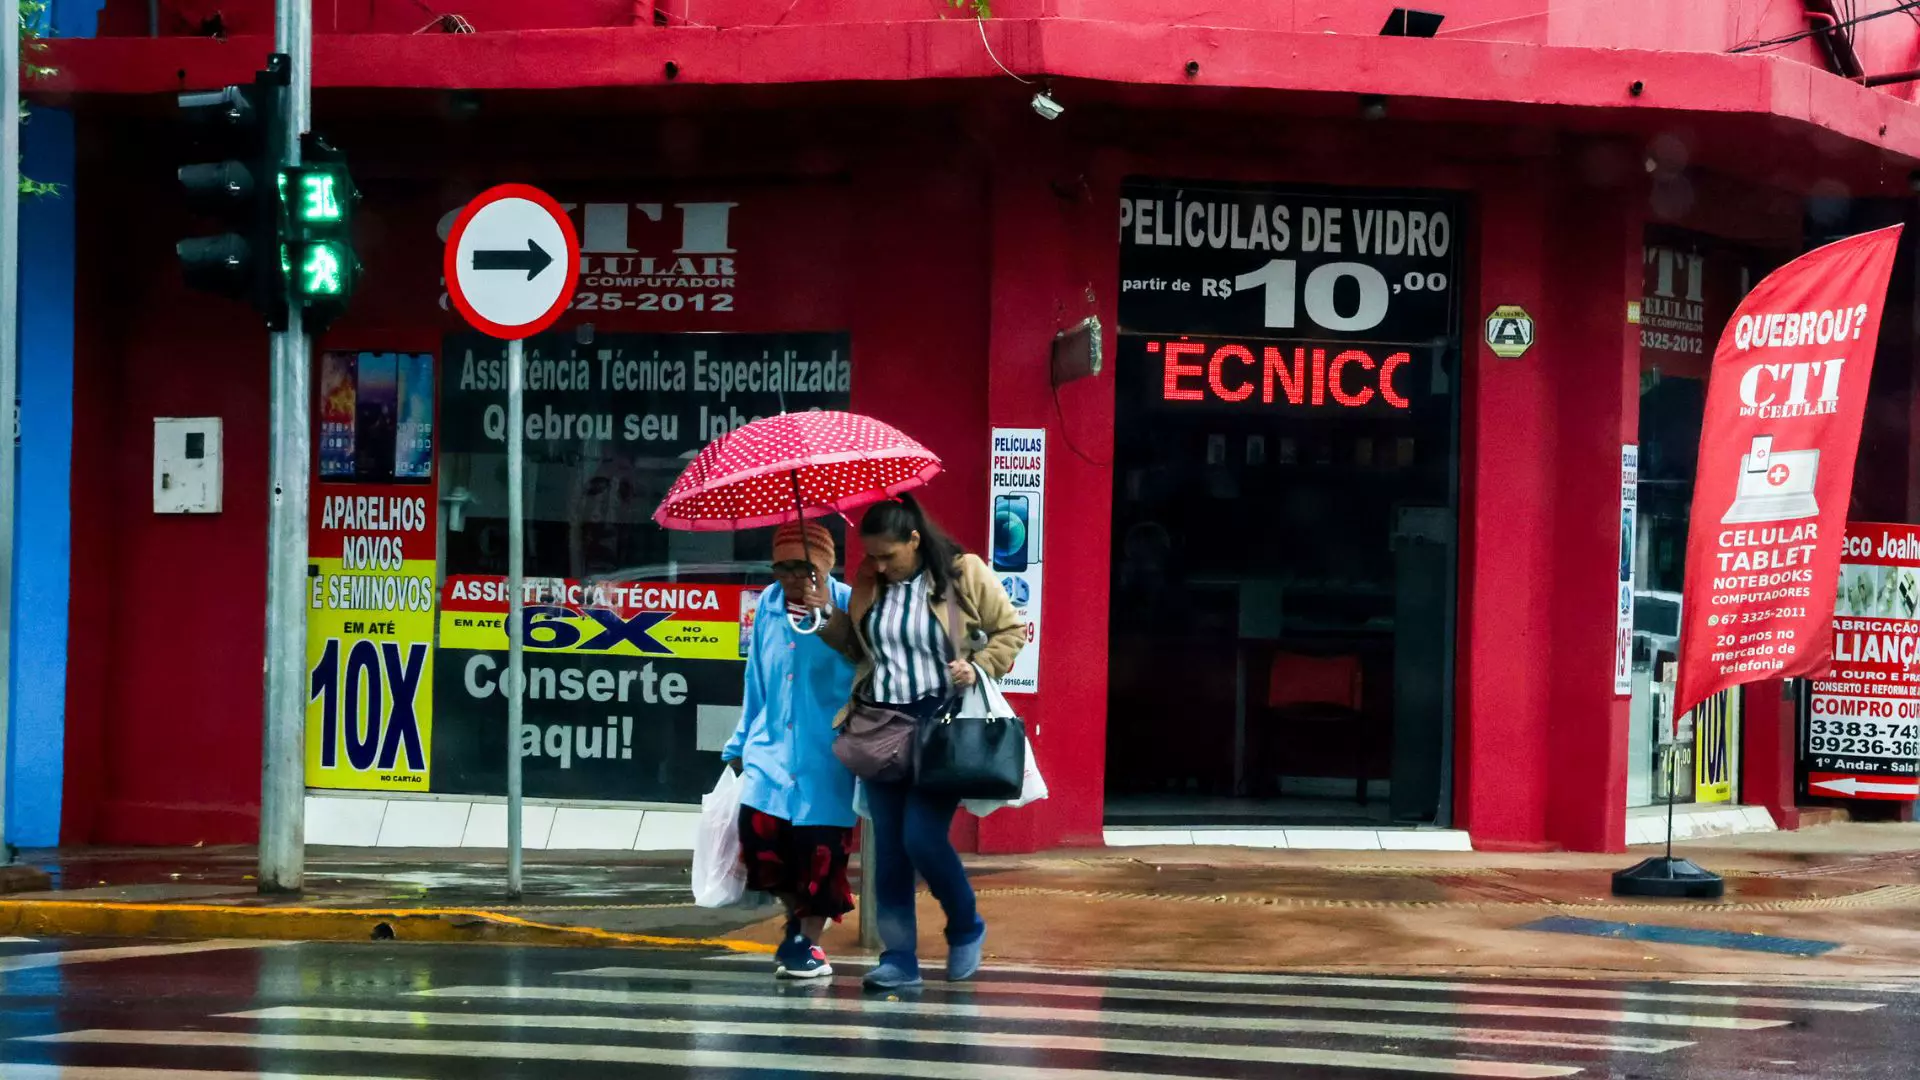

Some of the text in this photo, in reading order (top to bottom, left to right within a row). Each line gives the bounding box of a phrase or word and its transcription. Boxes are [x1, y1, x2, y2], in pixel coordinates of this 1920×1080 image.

[1119, 190, 1450, 258] PELÍCULAS DE VIDRO
[579, 258, 737, 275] LULAR
[1642, 245, 1704, 302] TI
[585, 278, 736, 288] COMPUTADOR
[1122, 278, 1167, 292] partir
[1172, 279, 1191, 291] de
[566, 292, 734, 312] 25-2012
[1641, 297, 1703, 322] ELULAR
[1735, 304, 1867, 351] QUEBROU?
[1640, 330, 1703, 354] 3325-2012
[460, 349, 851, 402] Assitência Técnica Especializada
[1739, 358, 1845, 408] CTI
[1739, 400, 1837, 419] DO CELULAR
[483, 404, 613, 442] Qebrou
[623, 410, 678, 441] seu
[995, 434, 1042, 452] PELÍCULAS
[994, 453, 1041, 470] PELÍCULAS
[993, 470, 1040, 488] PELÍCULAS
[321, 496, 426, 532] APARELHOS
[1718, 523, 1818, 548] CELULAR
[1877, 531, 1920, 560] Joalh
[342, 536, 403, 571] NOVOS
[1716, 545, 1817, 572] TABLET
[1713, 569, 1813, 590] NOTEBOOKS
[311, 574, 432, 612] E SEMINOVOS
[614, 582, 719, 610] TÉCNICA
[1711, 586, 1810, 605] COMPUTADORES
[454, 617, 502, 628] EM ATÉ
[1721, 607, 1806, 625] 67 3325-2011
[1832, 619, 1919, 634] ABRICAÇÃO
[343, 620, 395, 635] EM ATÉ
[504, 605, 676, 654] 6X
[665, 634, 719, 644] CARTÃO
[1716, 630, 1795, 647] 20 anos no
[1711, 643, 1796, 662] mercado de
[1830, 633, 1920, 671] LIANÇ
[1720, 658, 1784, 675] telefonia
[1841, 670, 1887, 681] OURO
[1890, 672, 1899, 681] E
[464, 654, 688, 705] Conserte
[1812, 681, 1862, 693] CONSERTO
[1864, 684, 1870, 694] E
[1872, 684, 1908, 696] REFORMA
[310, 638, 430, 772] 10X
[1812, 697, 1893, 718] COMPRO
[521, 716, 634, 769] aqui!
[1835, 759, 1879, 771] Andar
[1890, 762, 1914, 773] Sala
[393, 775, 422, 783] CARTÃO
